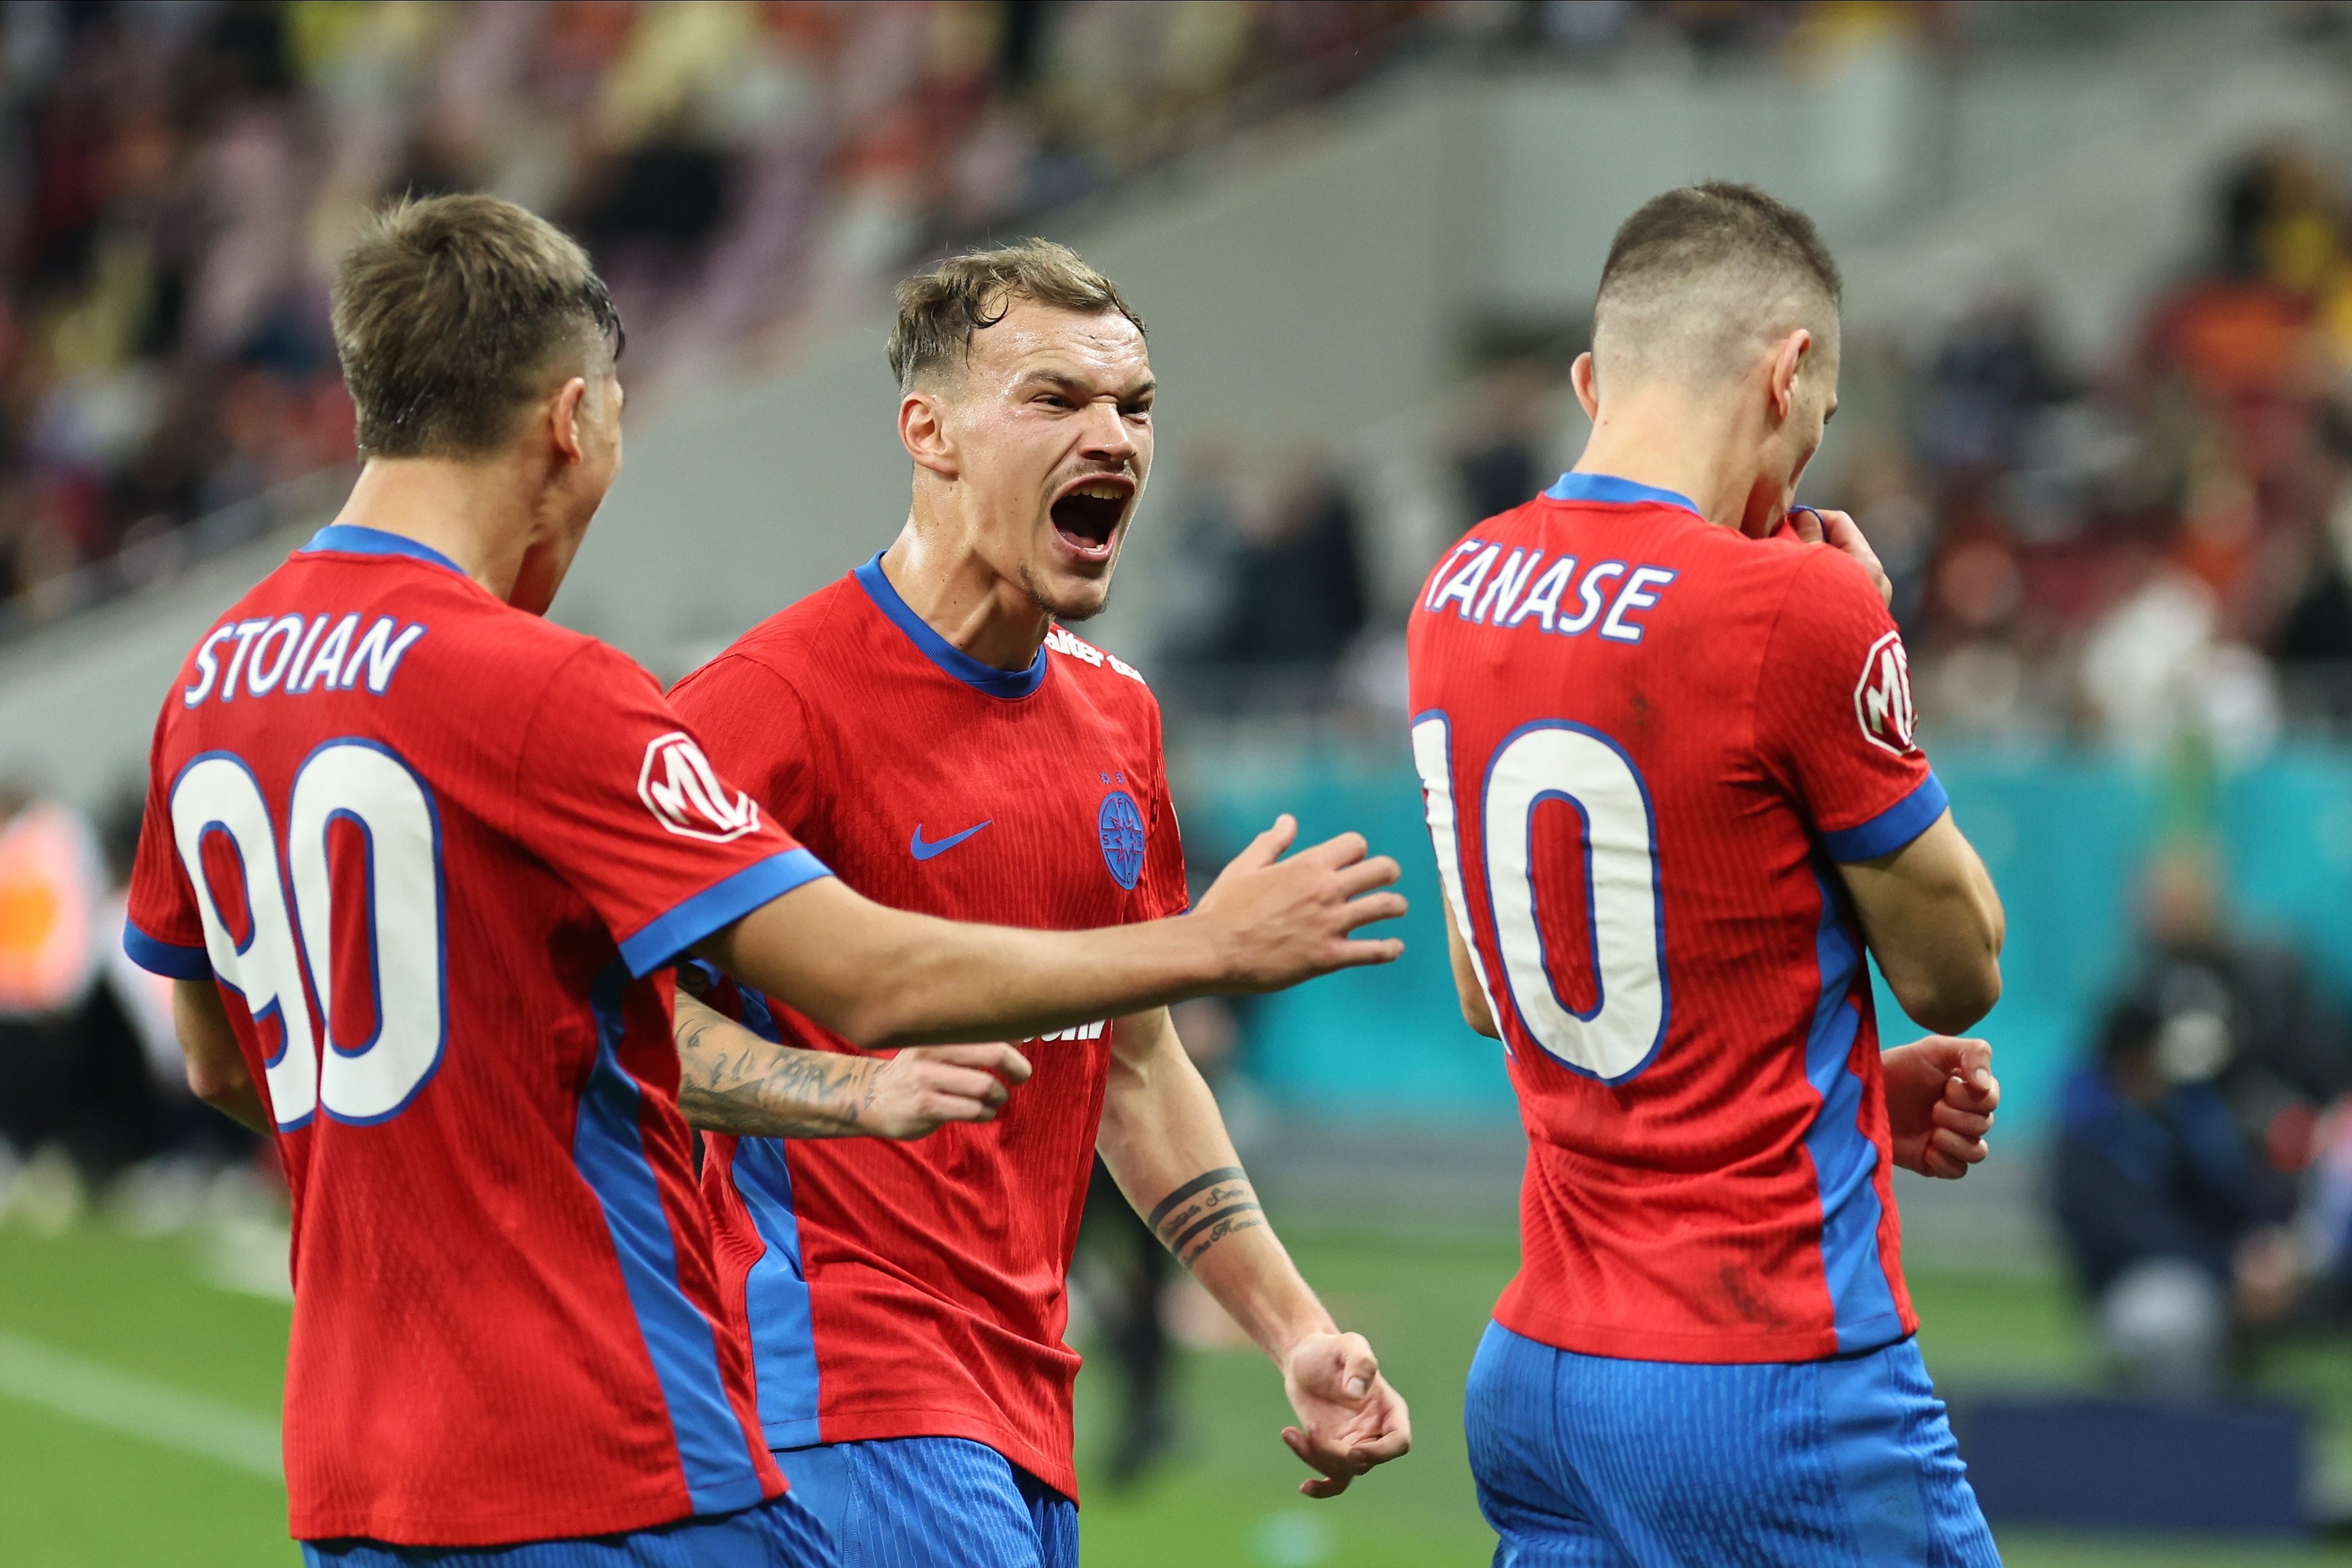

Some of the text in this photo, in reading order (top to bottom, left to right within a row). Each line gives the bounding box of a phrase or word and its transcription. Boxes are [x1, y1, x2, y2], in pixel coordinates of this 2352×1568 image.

[1424, 538, 1680, 645] TANASE
[184, 612, 427, 710] STOIAN
[1044, 629, 1104, 667] alter
[169, 736, 448, 1133] 90
[1411, 708, 1670, 1087] 10
